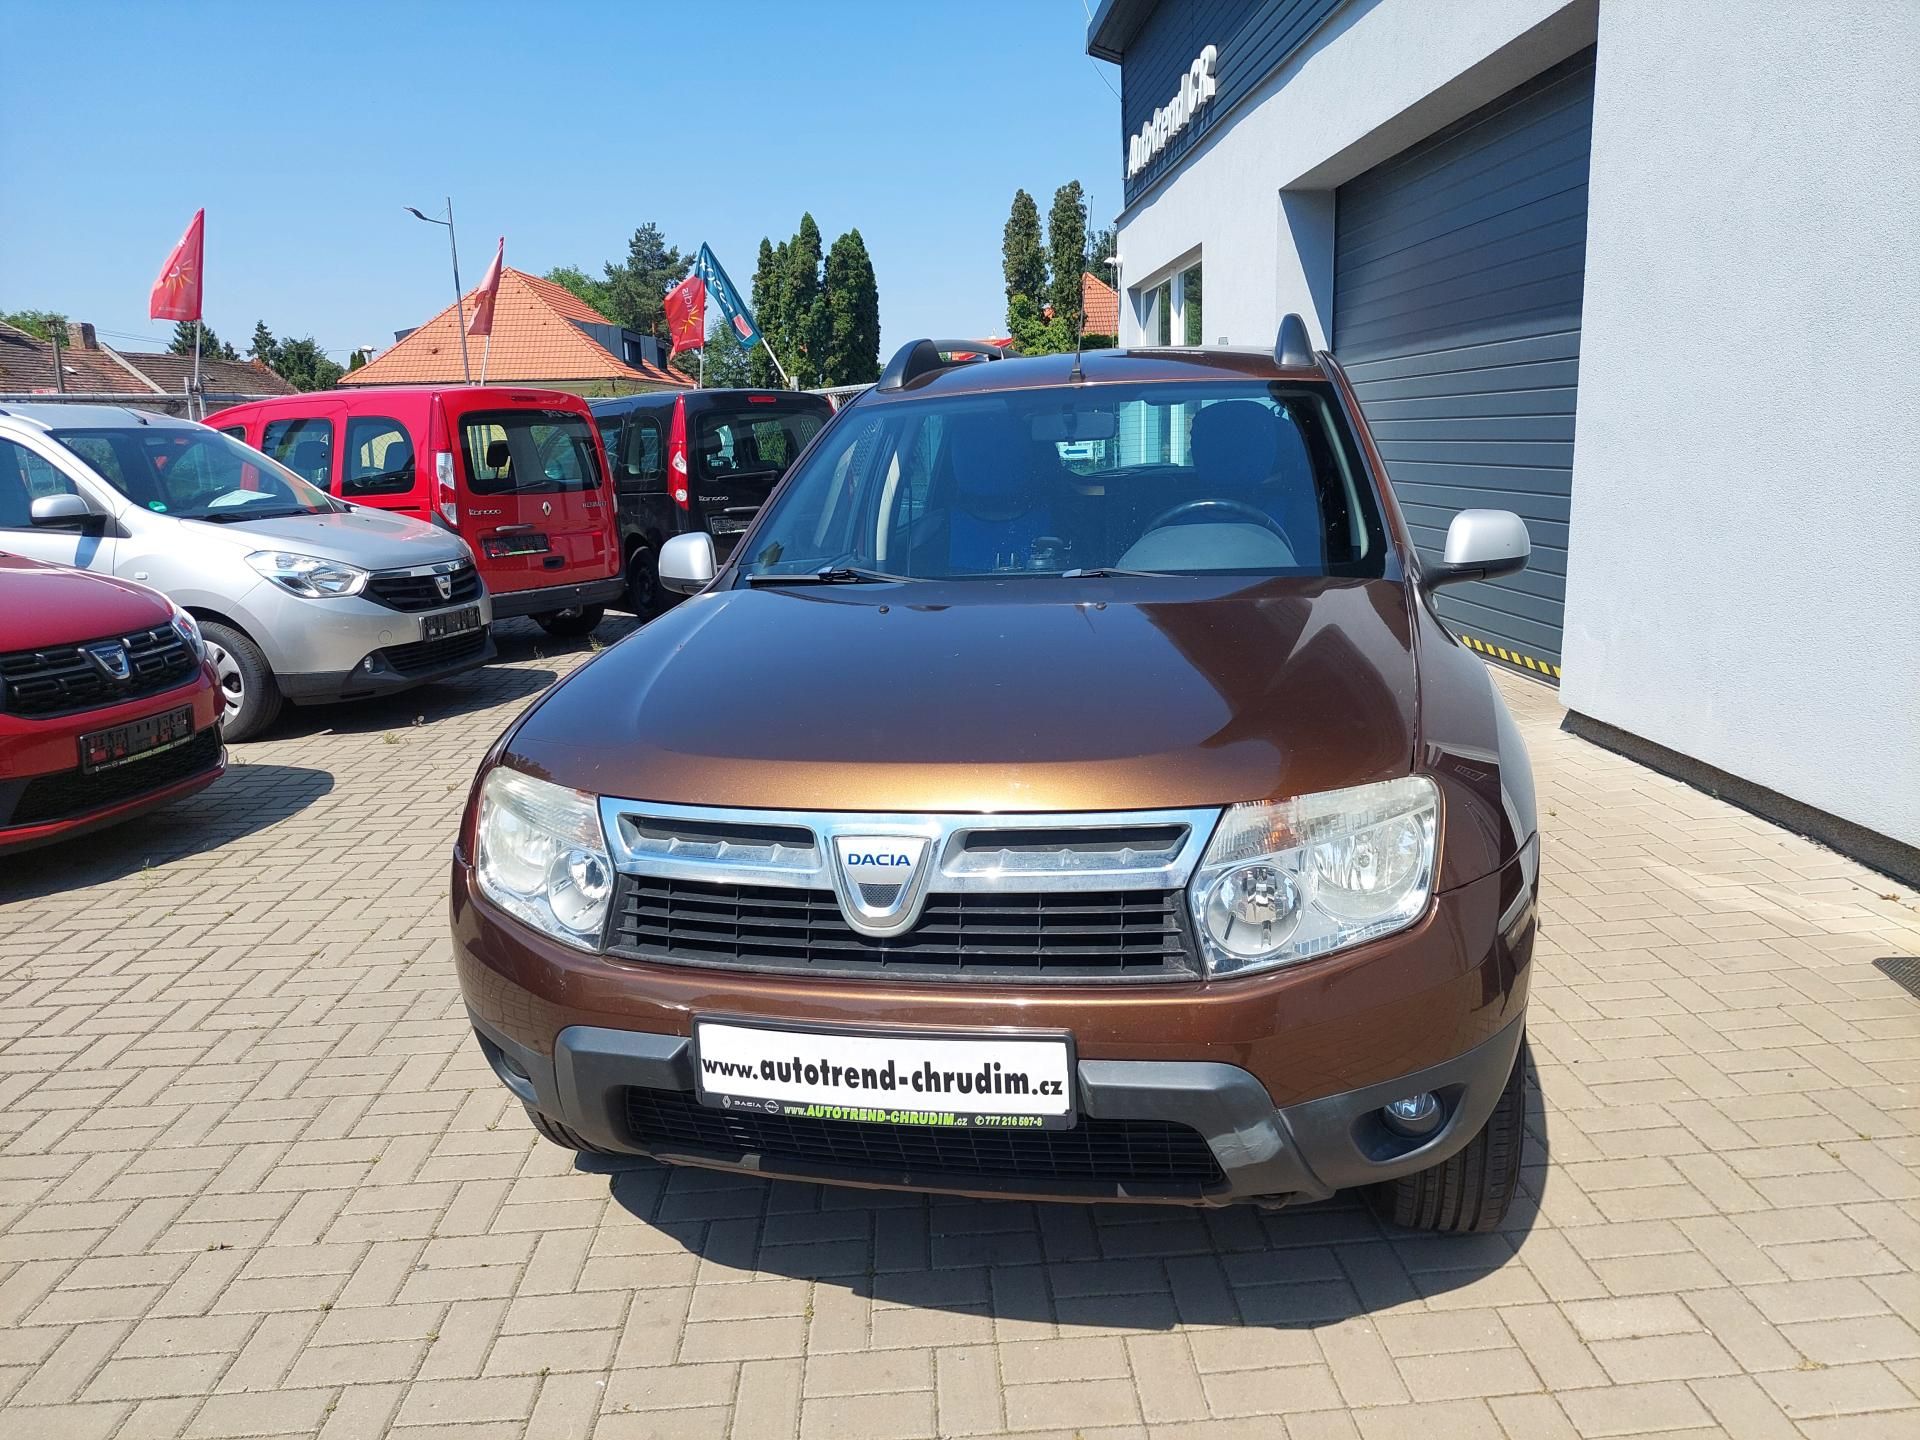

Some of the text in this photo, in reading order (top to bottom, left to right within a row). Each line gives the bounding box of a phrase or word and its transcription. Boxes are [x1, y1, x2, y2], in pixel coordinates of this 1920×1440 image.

[848, 853, 911, 866] DACIA
[702, 1057, 1063, 1096] www.autotrend-chrudim.cz
[784, 1104, 968, 1127] www.AUTOTREND-CHRUDIM.cz
[985, 1116, 1000, 1126] 777
[1001, 1116, 1018, 1126] 216
